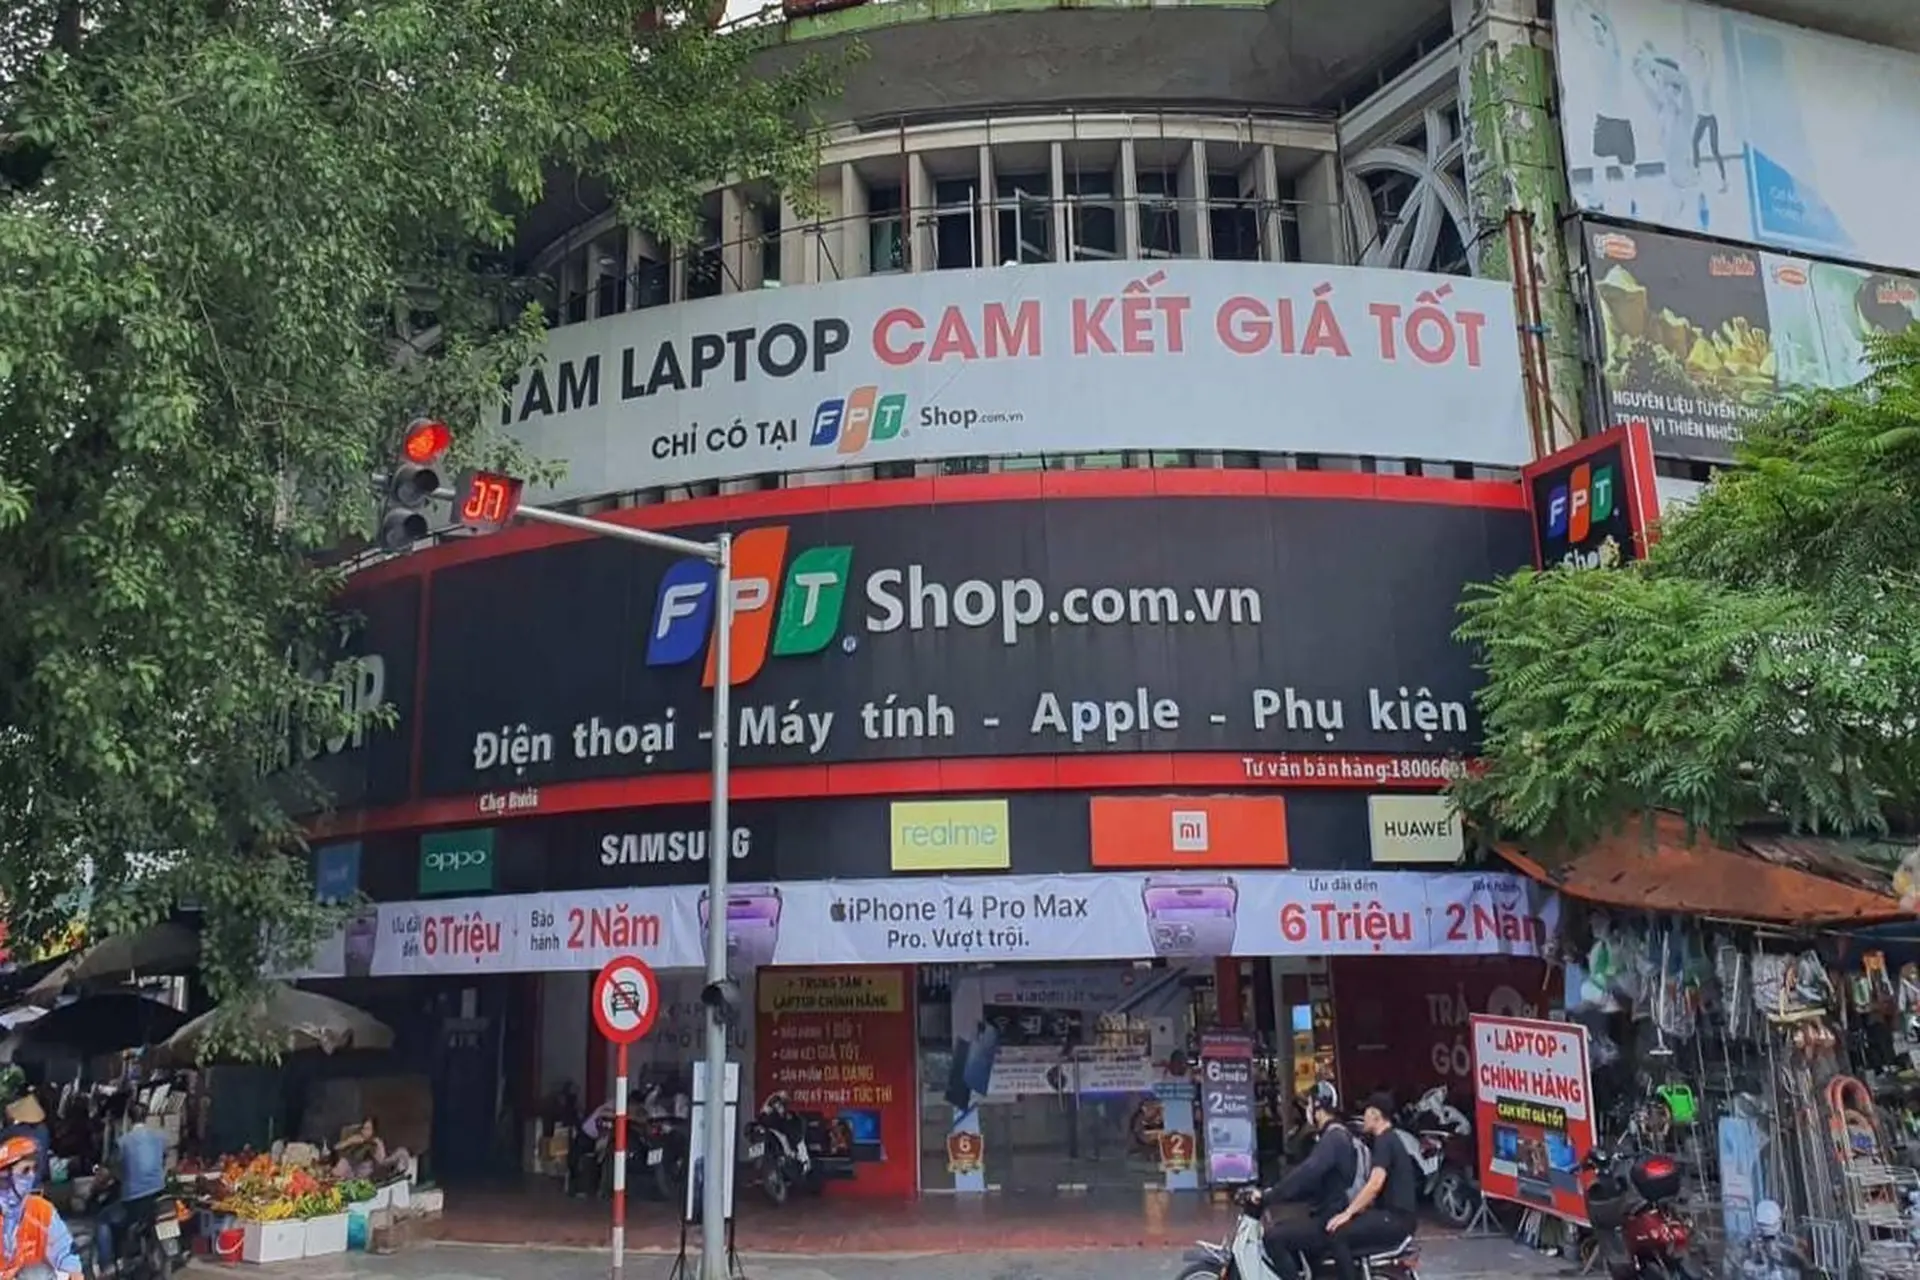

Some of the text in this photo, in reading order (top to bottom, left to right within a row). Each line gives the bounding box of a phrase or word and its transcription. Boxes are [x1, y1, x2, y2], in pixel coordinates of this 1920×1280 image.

[621, 317, 850, 401] LAPTOP
[872, 300, 1042, 366] CAM
[1072, 269, 1191, 356] KẾT
[1216, 281, 1352, 358] GIÁ
[1368, 282, 1486, 367] TỐT
[651, 422, 698, 459] CHỈ
[705, 418, 748, 452] CÓ
[756, 419, 798, 451] TẠI
[472, 722, 552, 774] Điện
[572, 707, 676, 762] thoại
[739, 699, 834, 754] Máy
[861, 693, 955, 739] tính
[1030, 686, 1181, 744] Apple
[1252, 687, 1345, 742] Phụ
[1368, 686, 1468, 742] kiện
[600, 828, 751, 866] SAMSUG
[900, 821, 998, 847] realme
[424, 848, 487, 872] oppo
[849, 895, 1088, 922] iPhone 14 Pro Max
[567, 903, 660, 950] 2 Năm
[932, 927, 984, 952] Vượt
[1493, 1029, 1558, 1058] LAPTOP
[1481, 1061, 1528, 1095] CHÍNH
